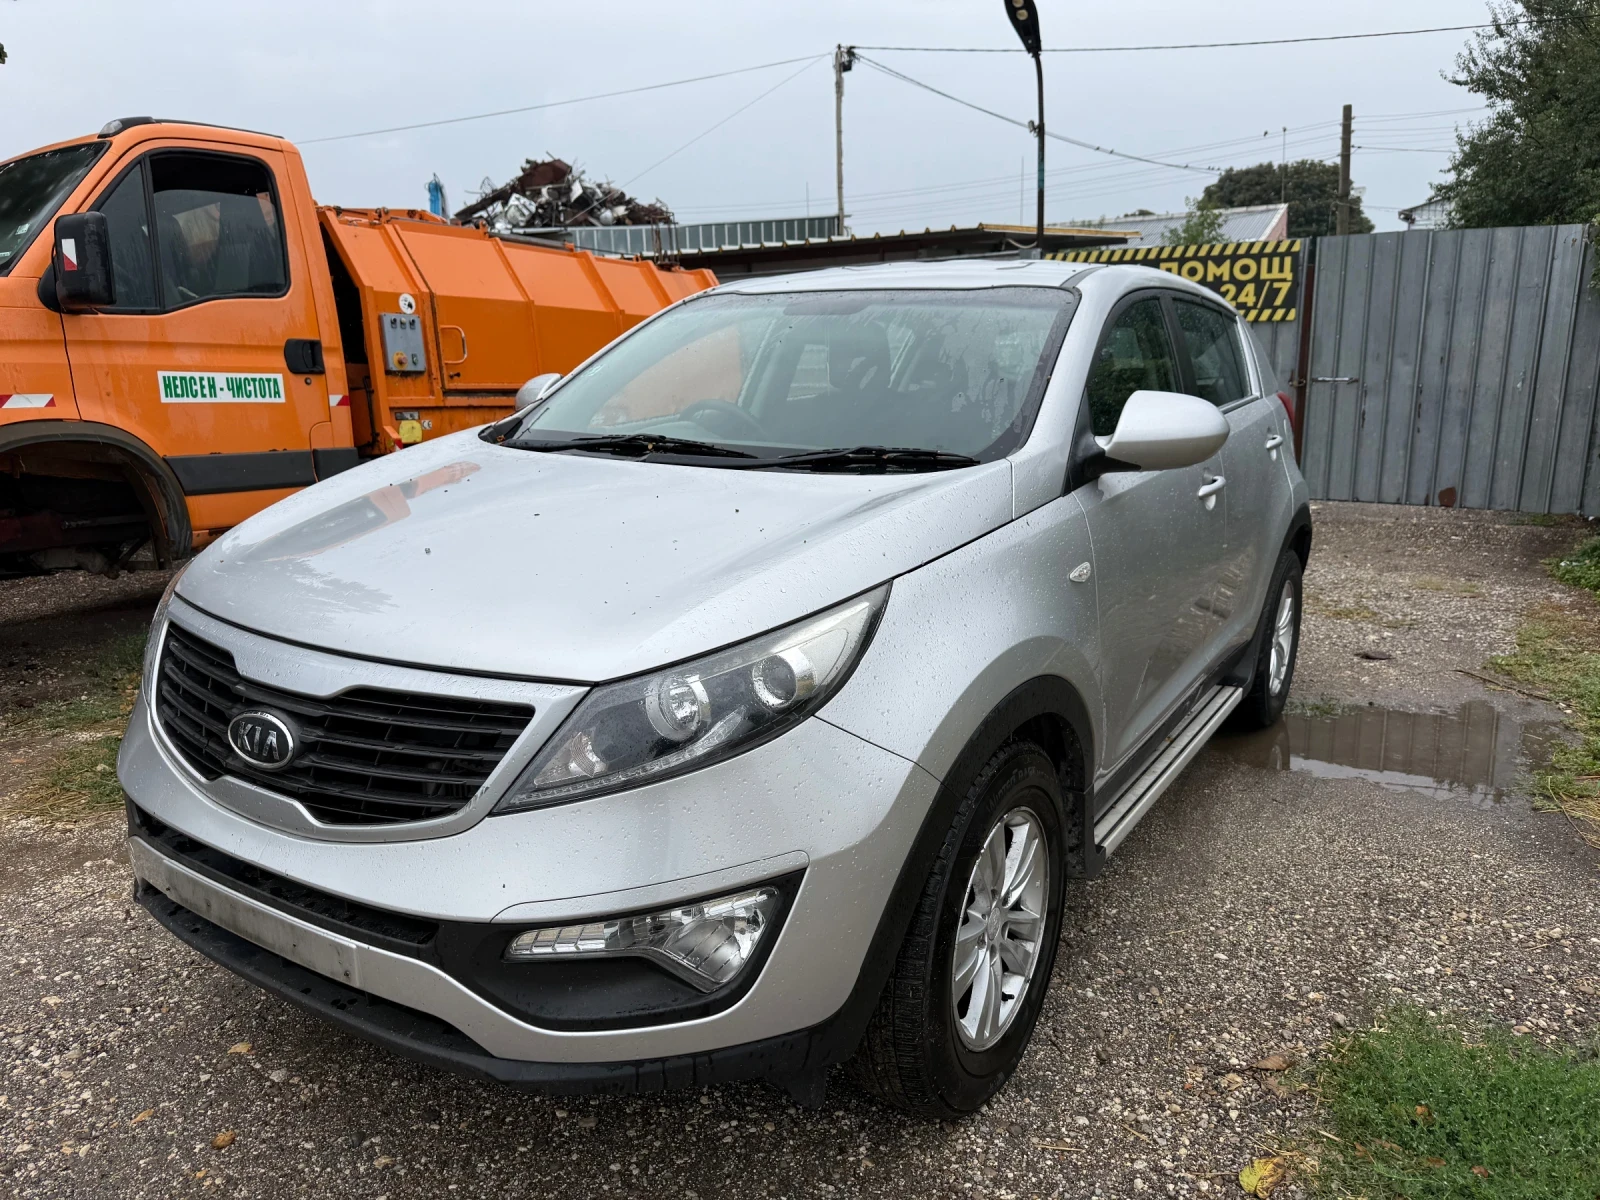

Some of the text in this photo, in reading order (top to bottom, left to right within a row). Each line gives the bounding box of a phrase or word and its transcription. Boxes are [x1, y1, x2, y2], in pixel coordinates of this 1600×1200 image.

[1219, 281, 1292, 309] 24/7
[162, 375, 217, 398] НЕЛСЕН
[226, 377, 281, 399] ЧИСТОТА
[237, 721, 280, 760] KIA
